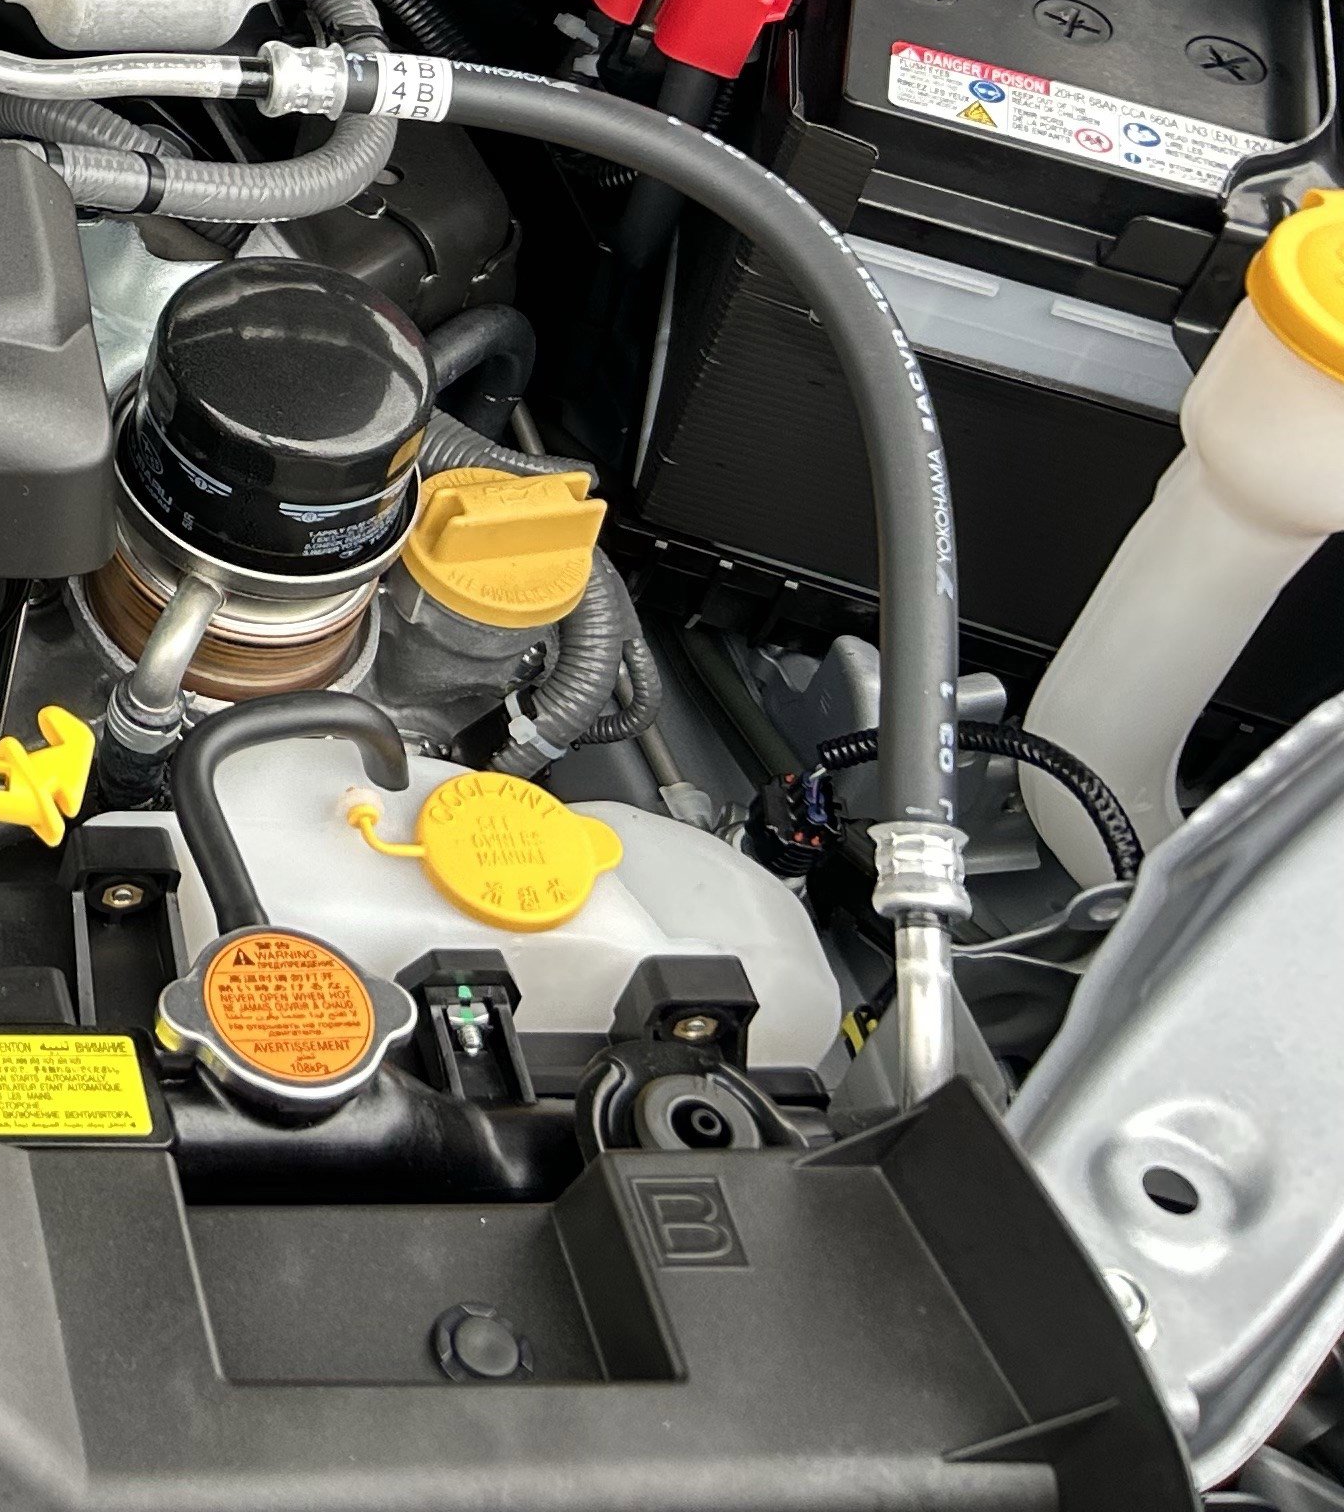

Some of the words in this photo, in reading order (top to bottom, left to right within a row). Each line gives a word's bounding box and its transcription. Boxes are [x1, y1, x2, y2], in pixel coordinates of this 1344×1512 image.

[922, 51, 982, 78] DANGER
[991, 68, 1046, 94] POISON
[1120, 104, 1147, 120] CCA
[926, 448, 953, 564] YOKOHAMA
[254, 950, 318, 960] WARNING
[220, 993, 255, 1003] NEVER
[259, 992, 288, 1003] OPEN
[293, 991, 325, 1001] WHEN
[329, 990, 351, 1000] HOT
[322, 999, 354, 1010] CHAUD
[253, 1039, 351, 1054] AVERTISSEMENT
[10, 1074, 40, 1082] STARTS
[651, 1193, 734, 1260] B
